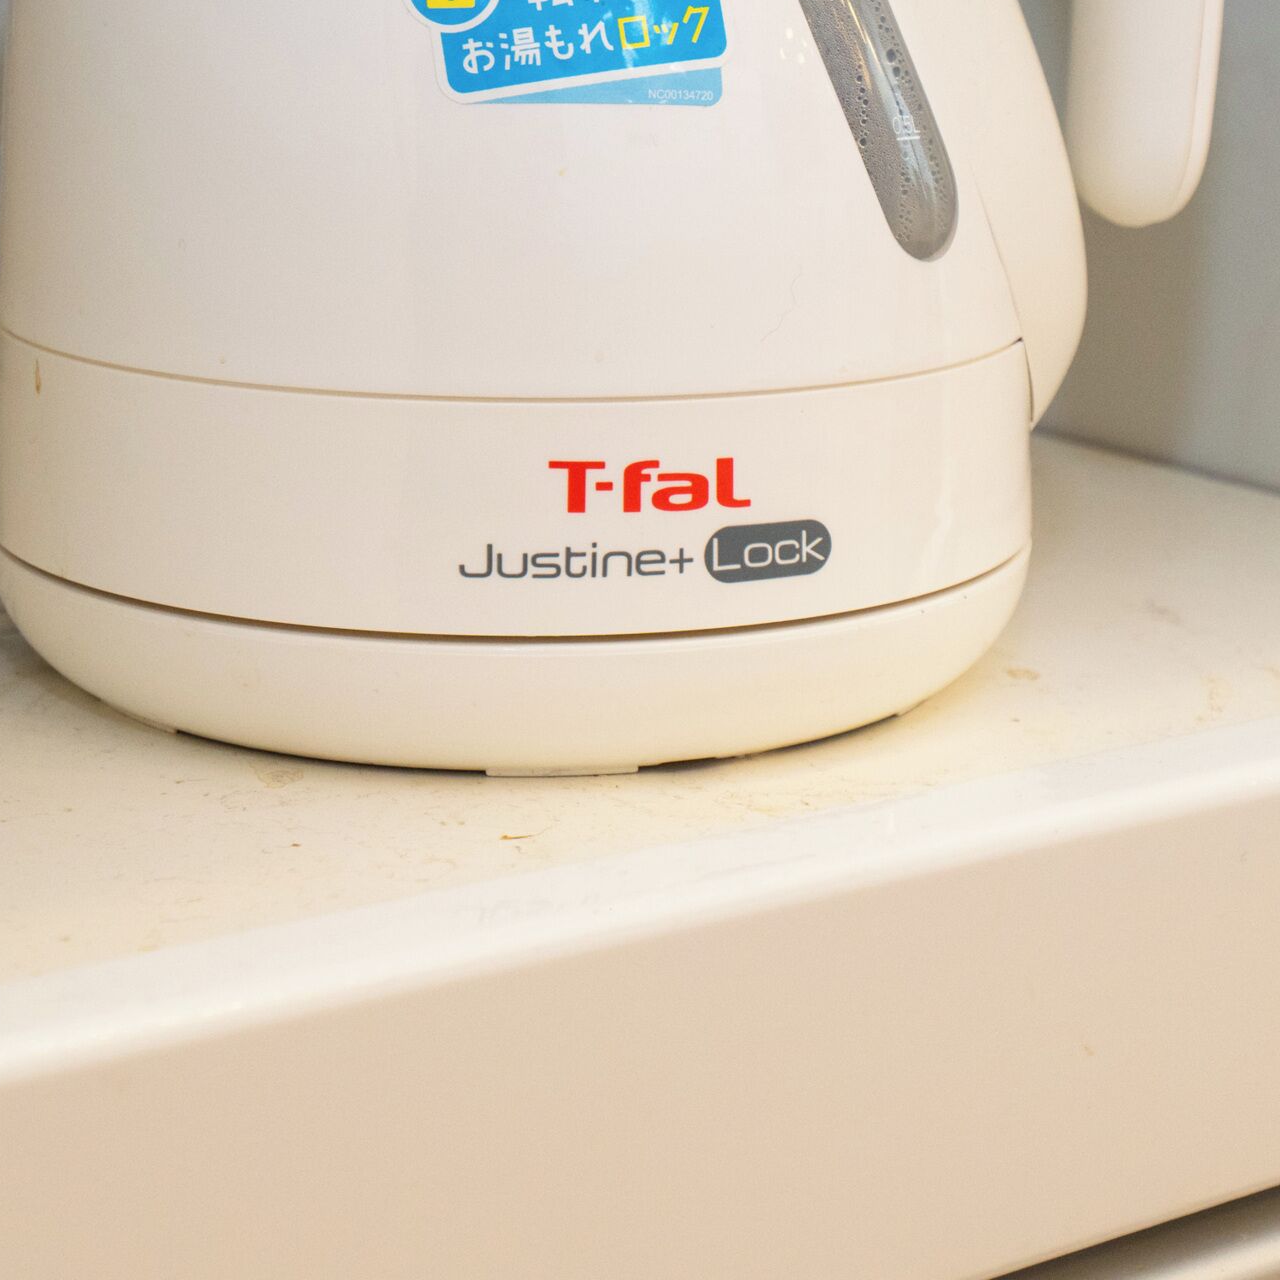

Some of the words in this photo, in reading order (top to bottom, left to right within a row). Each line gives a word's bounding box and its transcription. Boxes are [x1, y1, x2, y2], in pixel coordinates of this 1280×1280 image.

[462, 5, 710, 74] お湯もれロック
[647, 88, 714, 101] NC00134720
[548, 457, 752, 514] T-fal
[458, 543, 694, 579] Justine+
[712, 529, 825, 572] Lock
